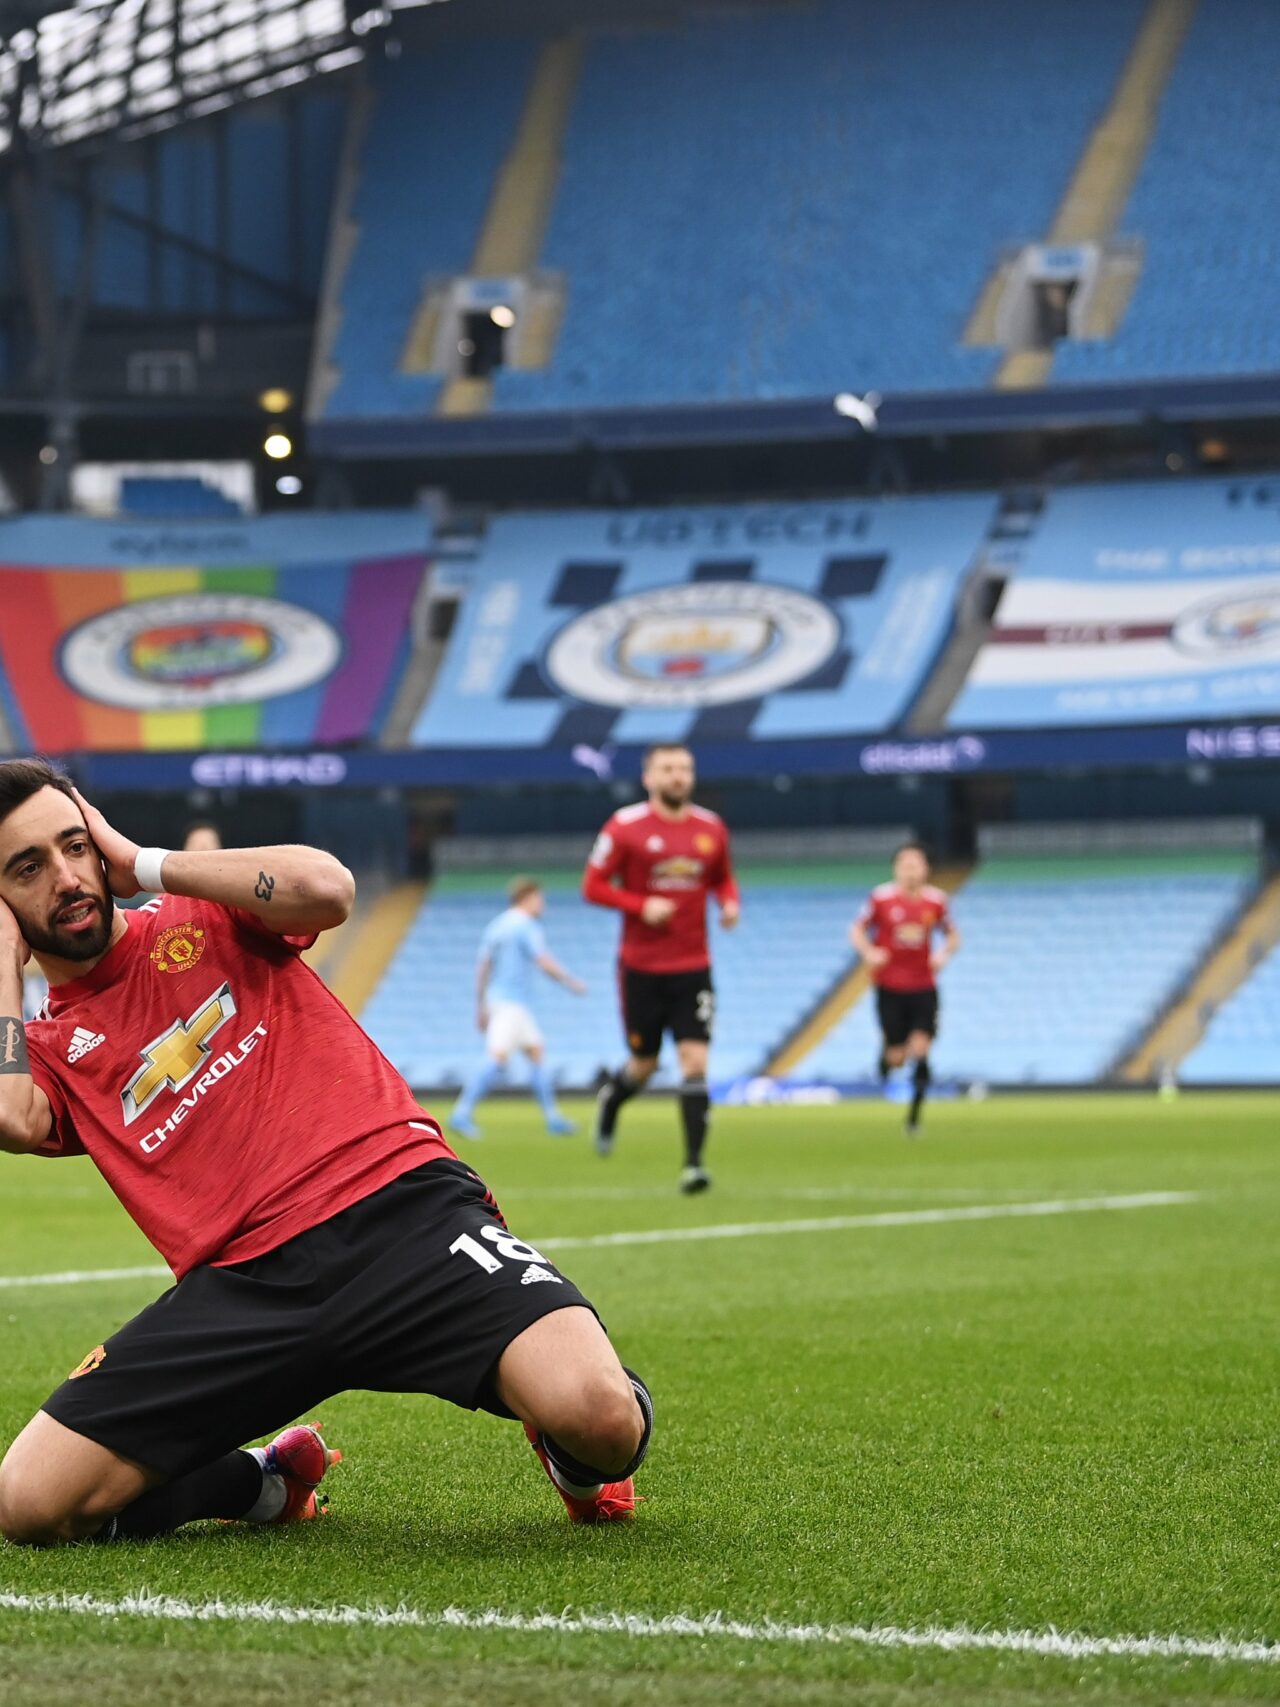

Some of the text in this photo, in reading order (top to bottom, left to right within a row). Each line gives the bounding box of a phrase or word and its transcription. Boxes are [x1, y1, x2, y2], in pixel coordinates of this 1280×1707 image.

[191, 754, 347, 787] ETIHAD
[254, 871, 275, 902] 23
[155, 926, 193, 959] MANCHESTER
[177, 946, 204, 971] UNITED
[67, 1033, 106, 1063] adidas
[139, 1020, 268, 1154] CHEVROLET
[448, 1224, 549, 1275] 18
